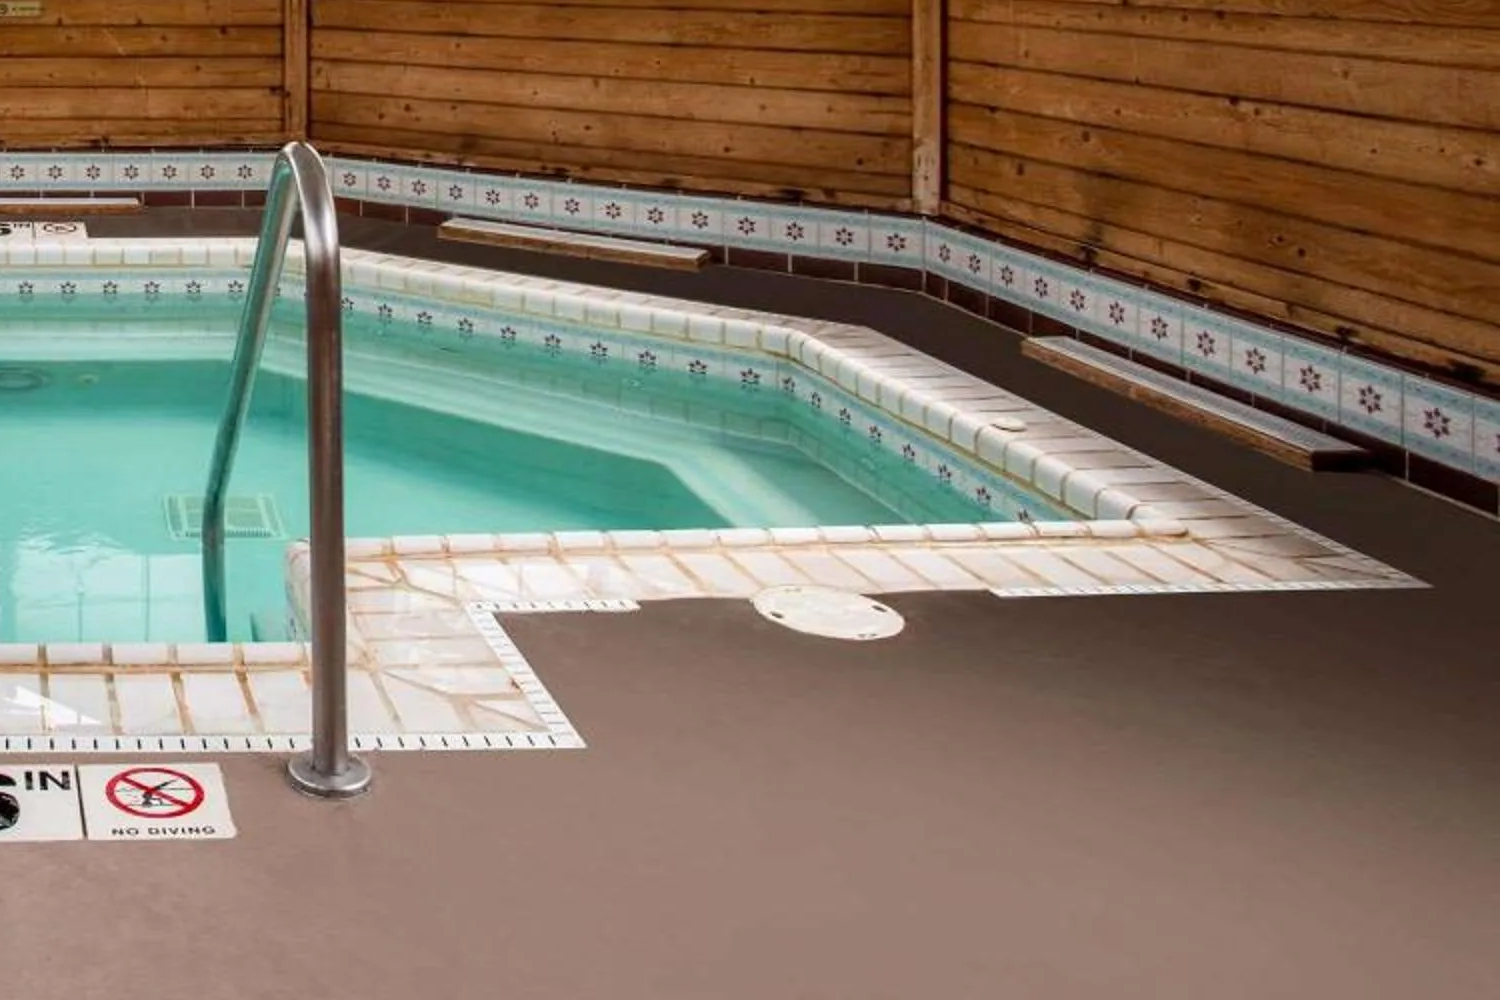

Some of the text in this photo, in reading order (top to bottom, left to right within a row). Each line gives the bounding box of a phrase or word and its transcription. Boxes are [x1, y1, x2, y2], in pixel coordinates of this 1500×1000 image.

[24, 770, 71, 791] IN
[111, 825, 216, 836] NO DIVING
